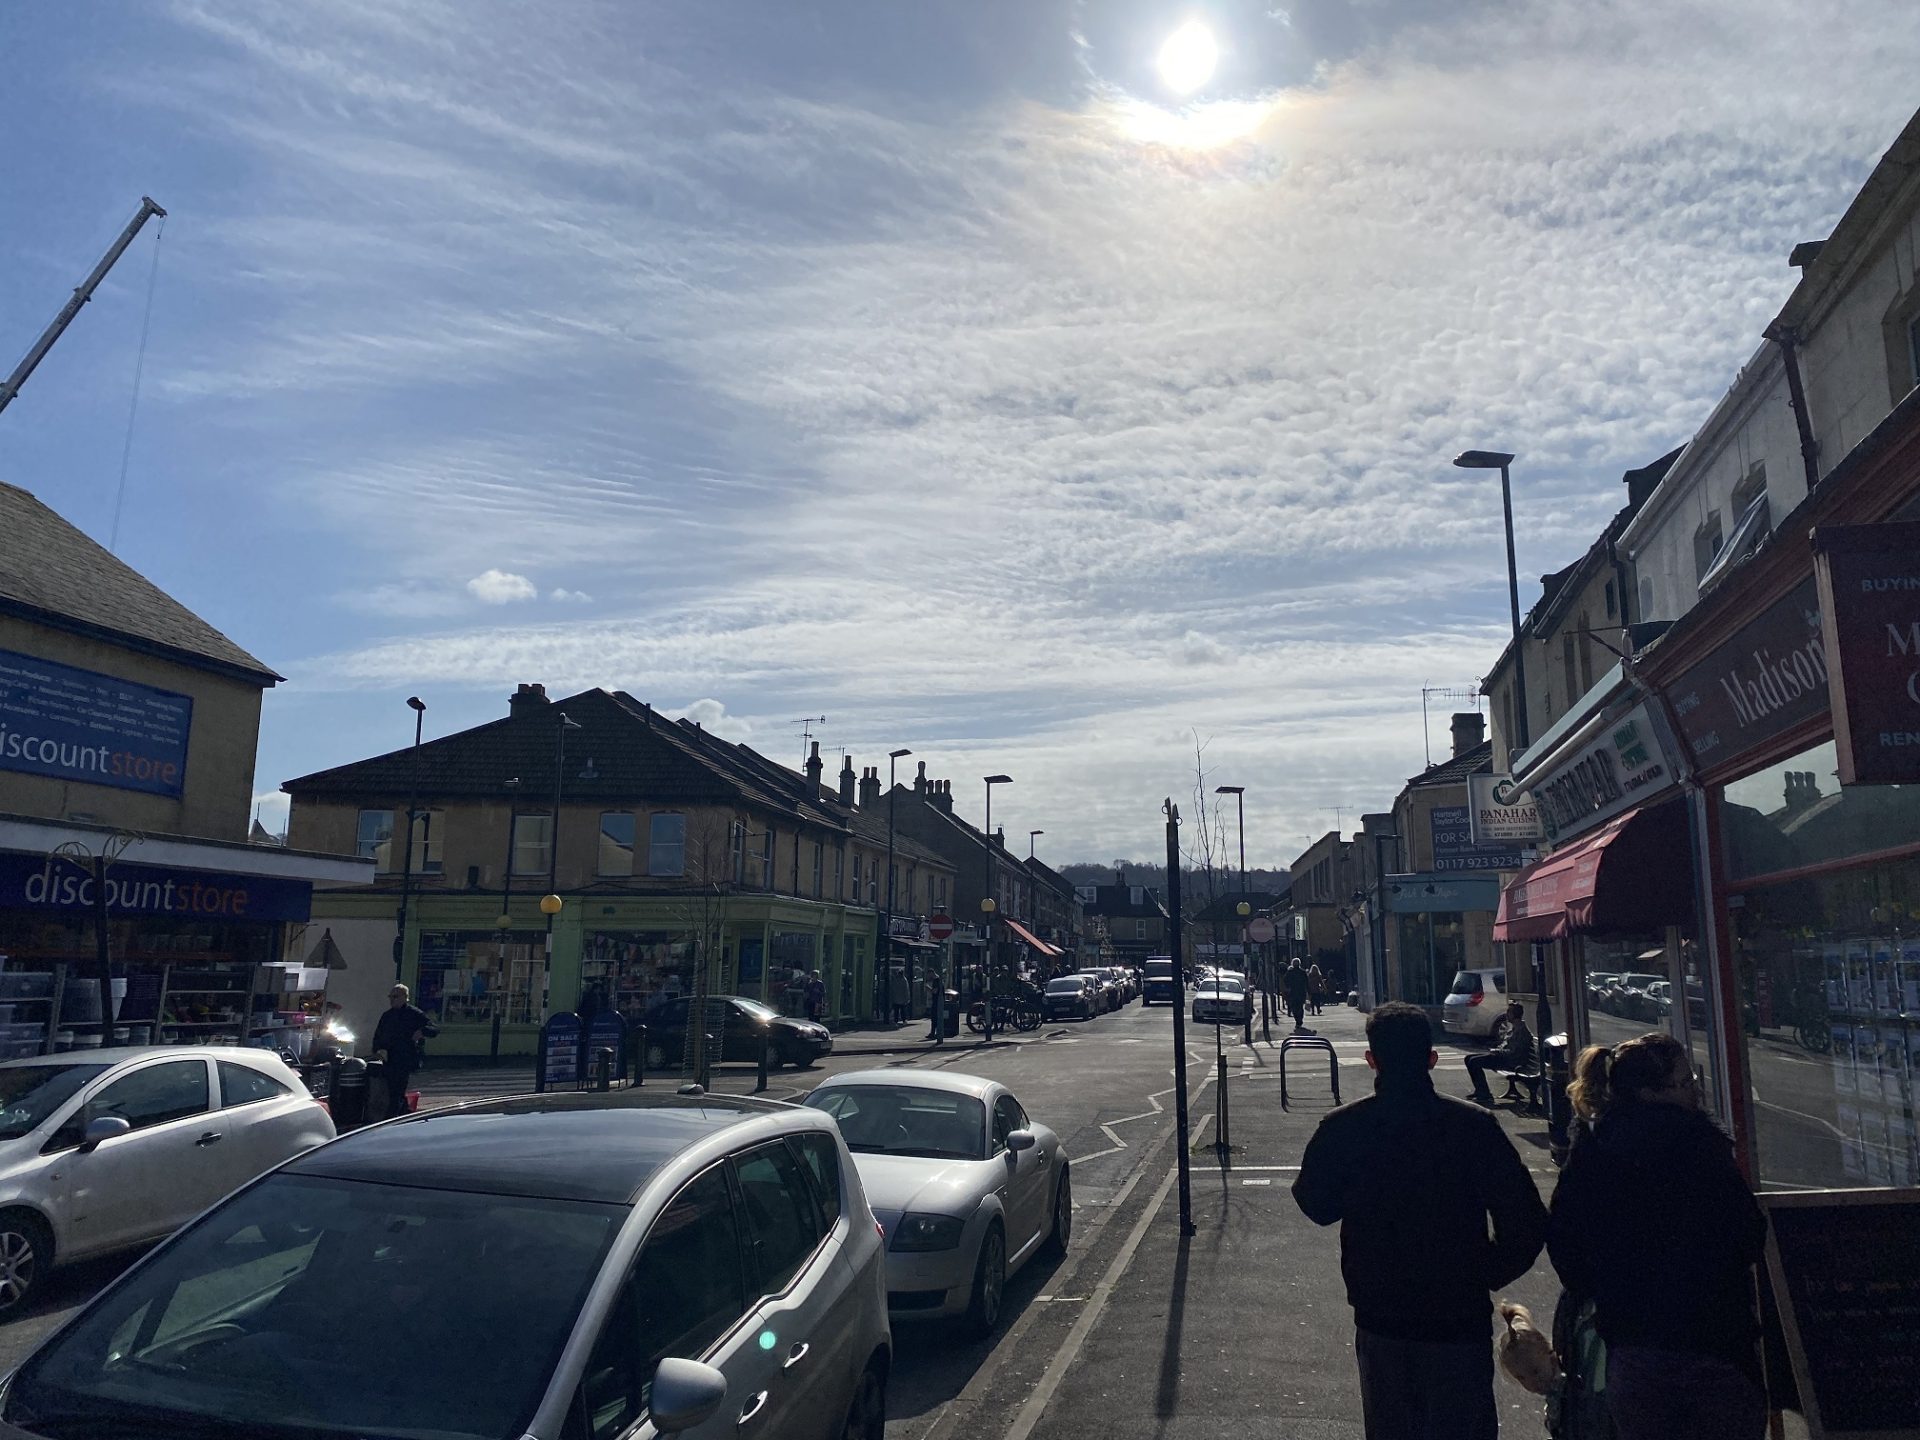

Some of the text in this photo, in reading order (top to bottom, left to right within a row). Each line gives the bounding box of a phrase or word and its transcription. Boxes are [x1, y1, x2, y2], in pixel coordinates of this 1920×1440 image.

[1433, 809, 1462, 818] Hartnell
[1480, 808, 1537, 819] PANAHAR
[1433, 816, 1471, 826] Taylor Coo
[1435, 831, 1472, 844] FOR SA
[1436, 856, 1521, 870] 0117 923 9234
